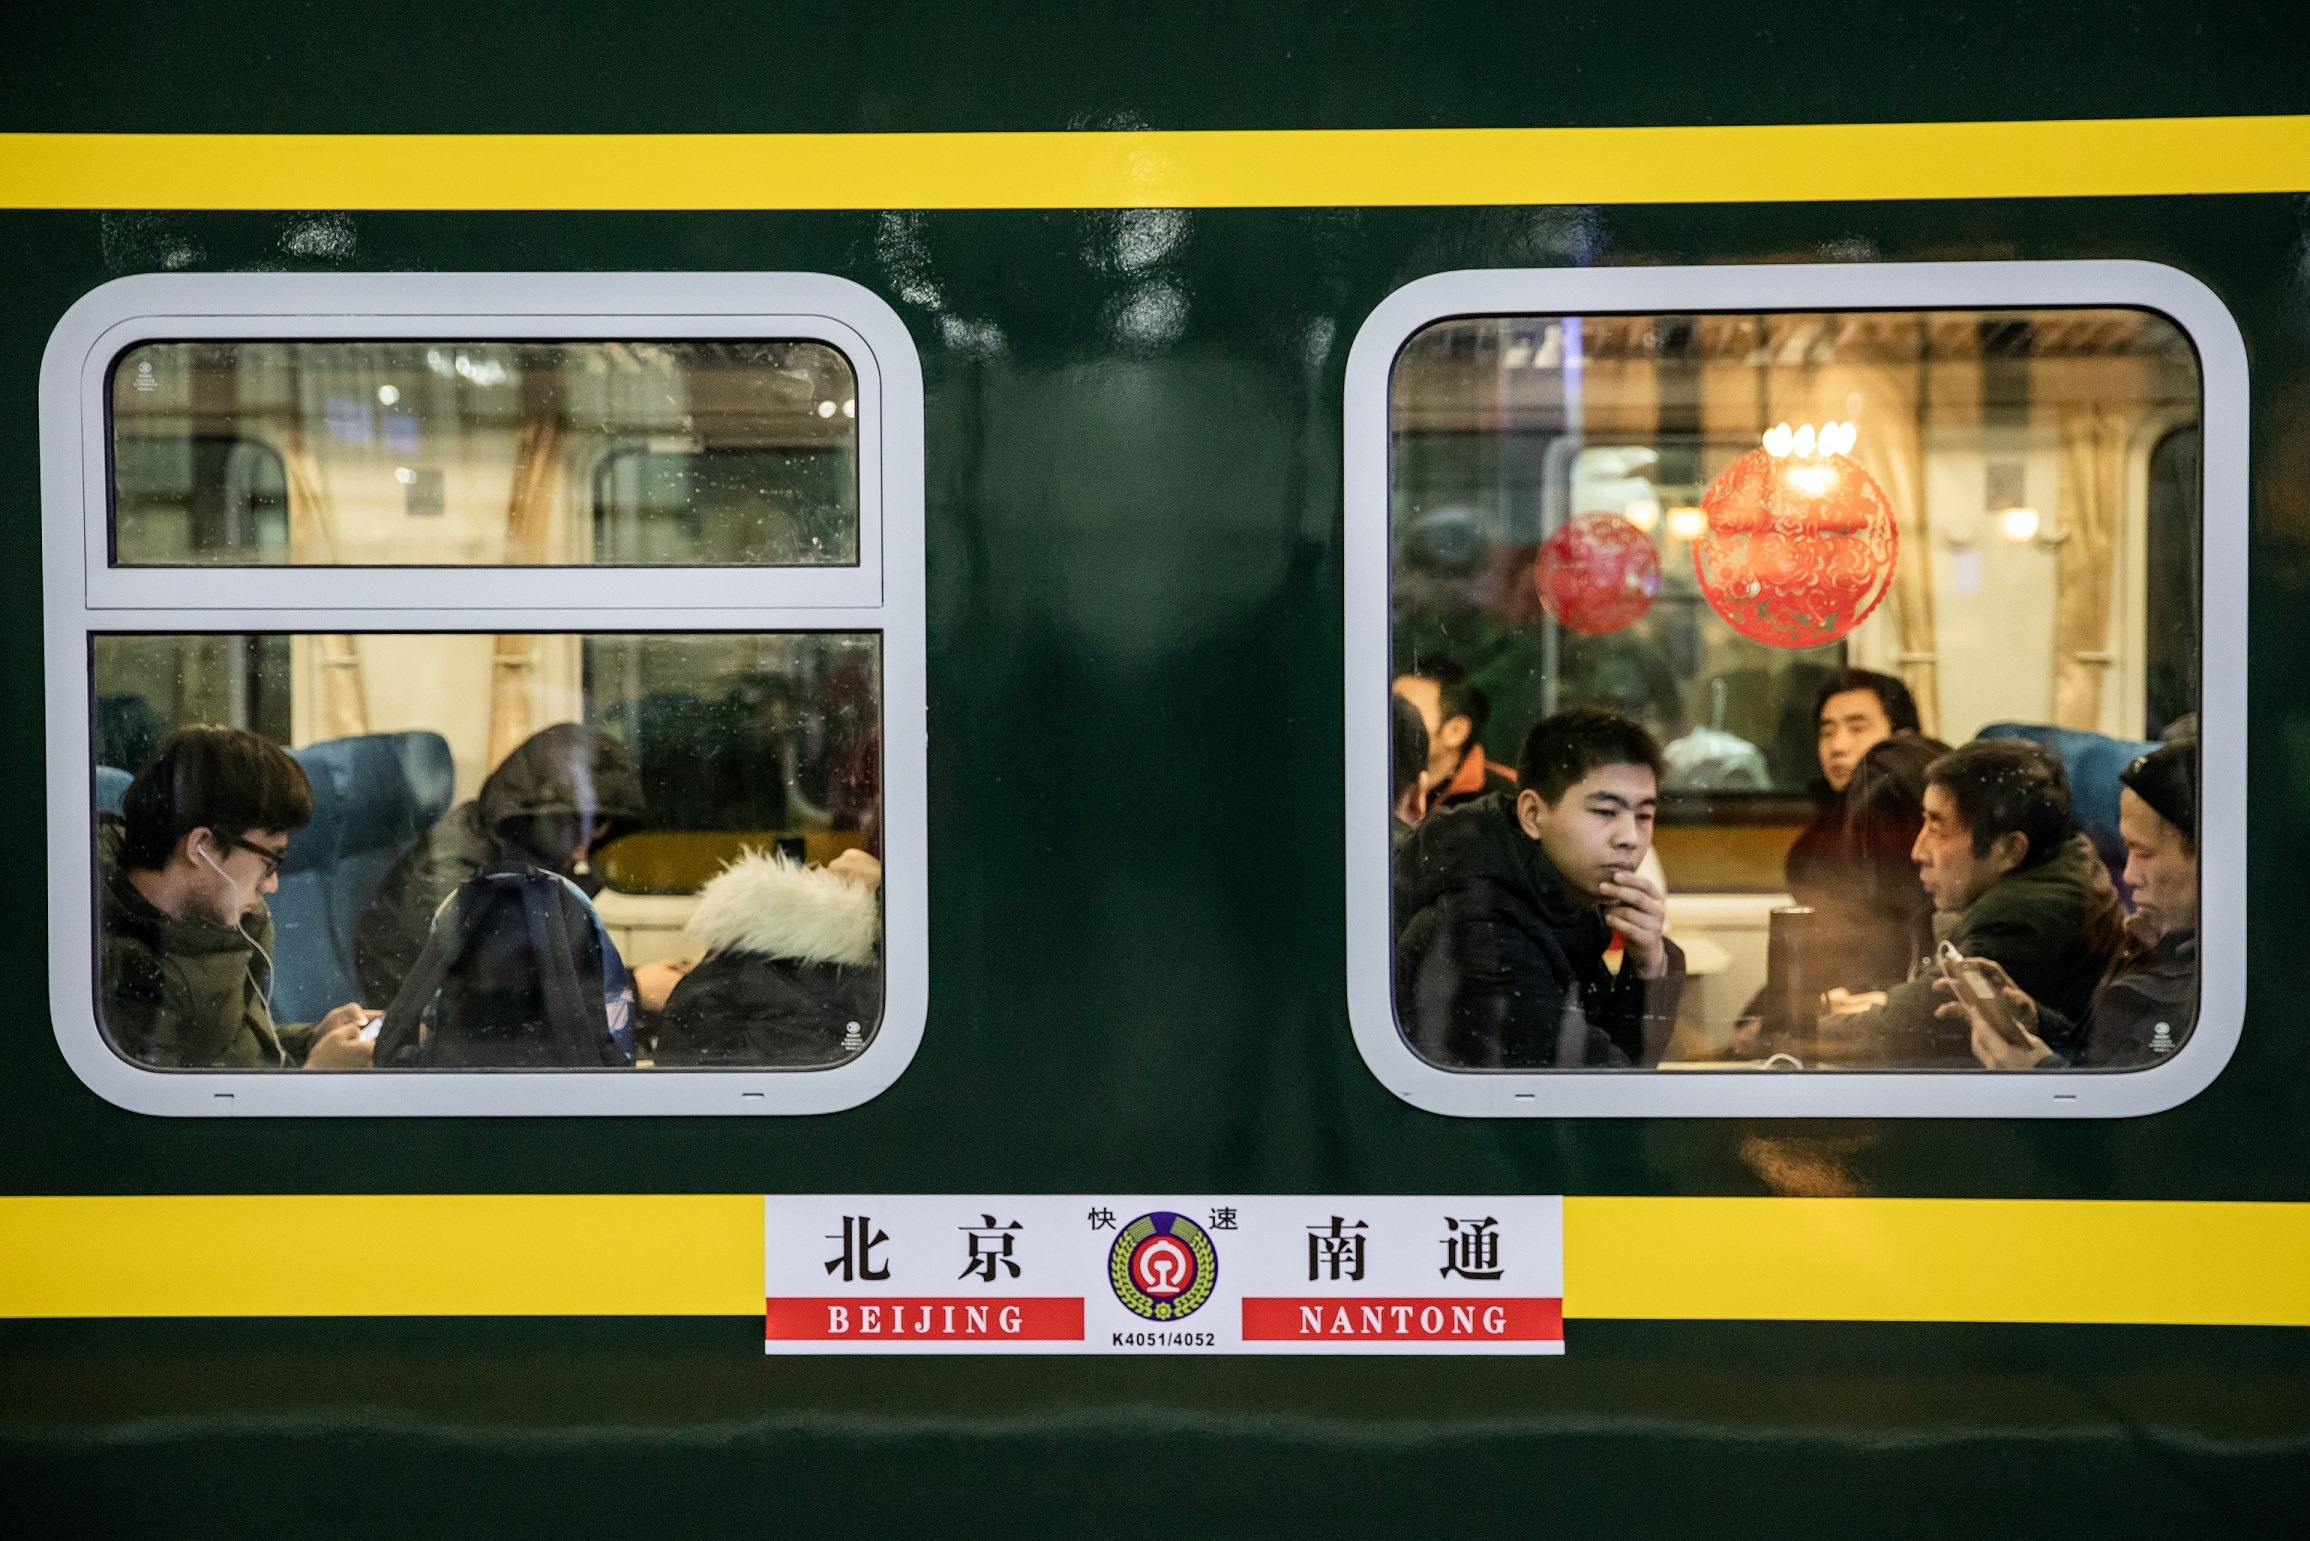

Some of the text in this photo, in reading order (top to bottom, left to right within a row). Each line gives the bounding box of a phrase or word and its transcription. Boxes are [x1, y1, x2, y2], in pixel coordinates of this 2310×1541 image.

[824, 1214, 1024, 1282] 北京
[1306, 1215, 1505, 1282] 南通
[827, 1305, 1024, 1334] BEIJING
[1299, 1306, 1508, 1335] NANTONG
[1112, 1332, 1215, 1347] K4051/4052
